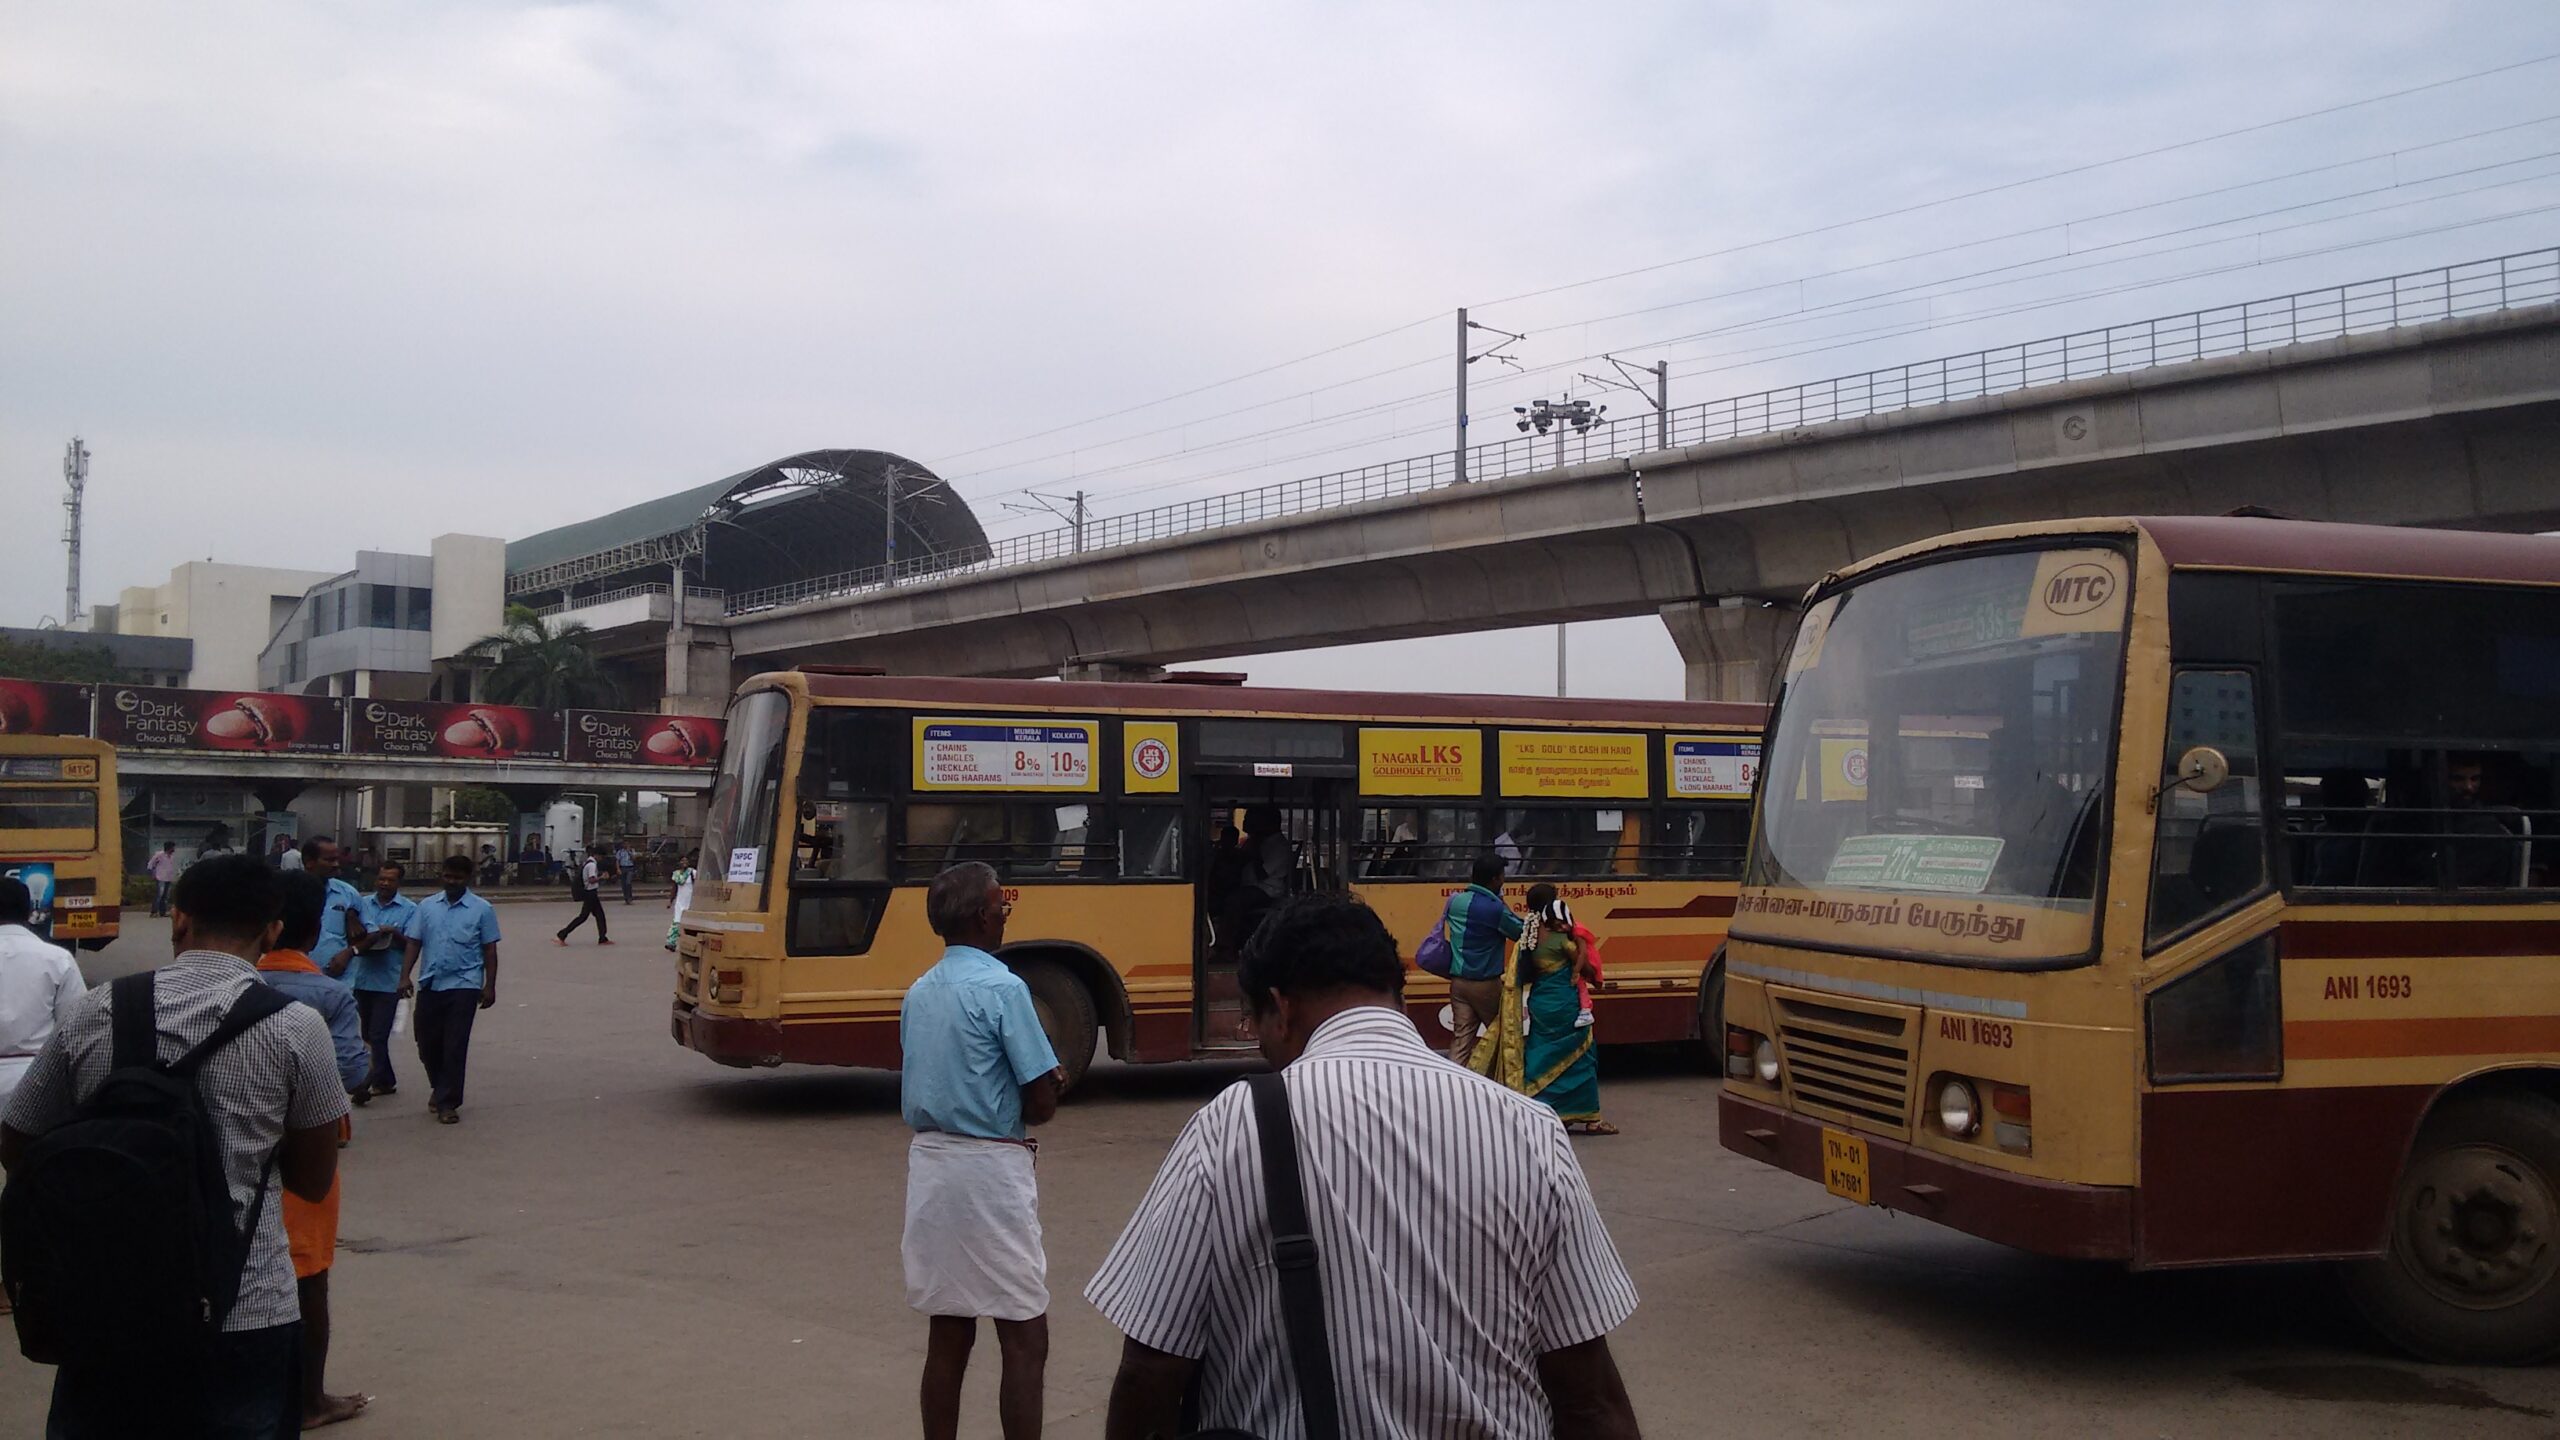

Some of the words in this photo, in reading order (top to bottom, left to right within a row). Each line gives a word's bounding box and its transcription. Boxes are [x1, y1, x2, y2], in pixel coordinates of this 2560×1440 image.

[2050, 576, 2106, 604] MTC
[140, 700, 184, 717] Dark
[126, 715, 198, 736] Fantasy
[388, 712, 425, 727] Dark
[375, 725, 438, 744] Fantasy
[599, 722, 631, 737] Dark
[136, 733, 166, 743] Choco
[169, 734, 186, 744] Fills
[588, 735, 642, 752] Fantasy
[383, 742, 410, 751] Choco
[412, 743, 427, 752] Fills
[937, 744, 967, 752] CHAINS
[1372, 753, 1419, 764] T.NAGAR
[1420, 745, 1462, 764] LKS
[1569, 745, 1577, 754] IS
[1579, 745, 1599, 754] CASH
[1601, 746, 1609, 755] IN
[1611, 746, 1632, 755] HAND
[937, 754, 974, 762] BANGLES
[1015, 750, 1041, 771] 8%
[1051, 752, 1087, 772] 10%
[1683, 758, 1707, 766] CHAINS
[68, 765, 90, 776] MTC
[937, 764, 978, 772] NECKLACE
[1373, 767, 1424, 775] GOLDHOUSE
[1427, 767, 1441, 775] PVT
[937, 774, 959, 782] LONG
[961, 774, 1002, 782] HAARAMS
[68, 898, 90, 906] STOP
[1907, 903, 2026, 943] பேருந்து
[2324, 976, 2359, 1000] ANI
[2366, 974, 2412, 999] 1693
[1940, 1016, 1967, 1042] ANI
[1972, 1018, 2014, 1049] 1693
